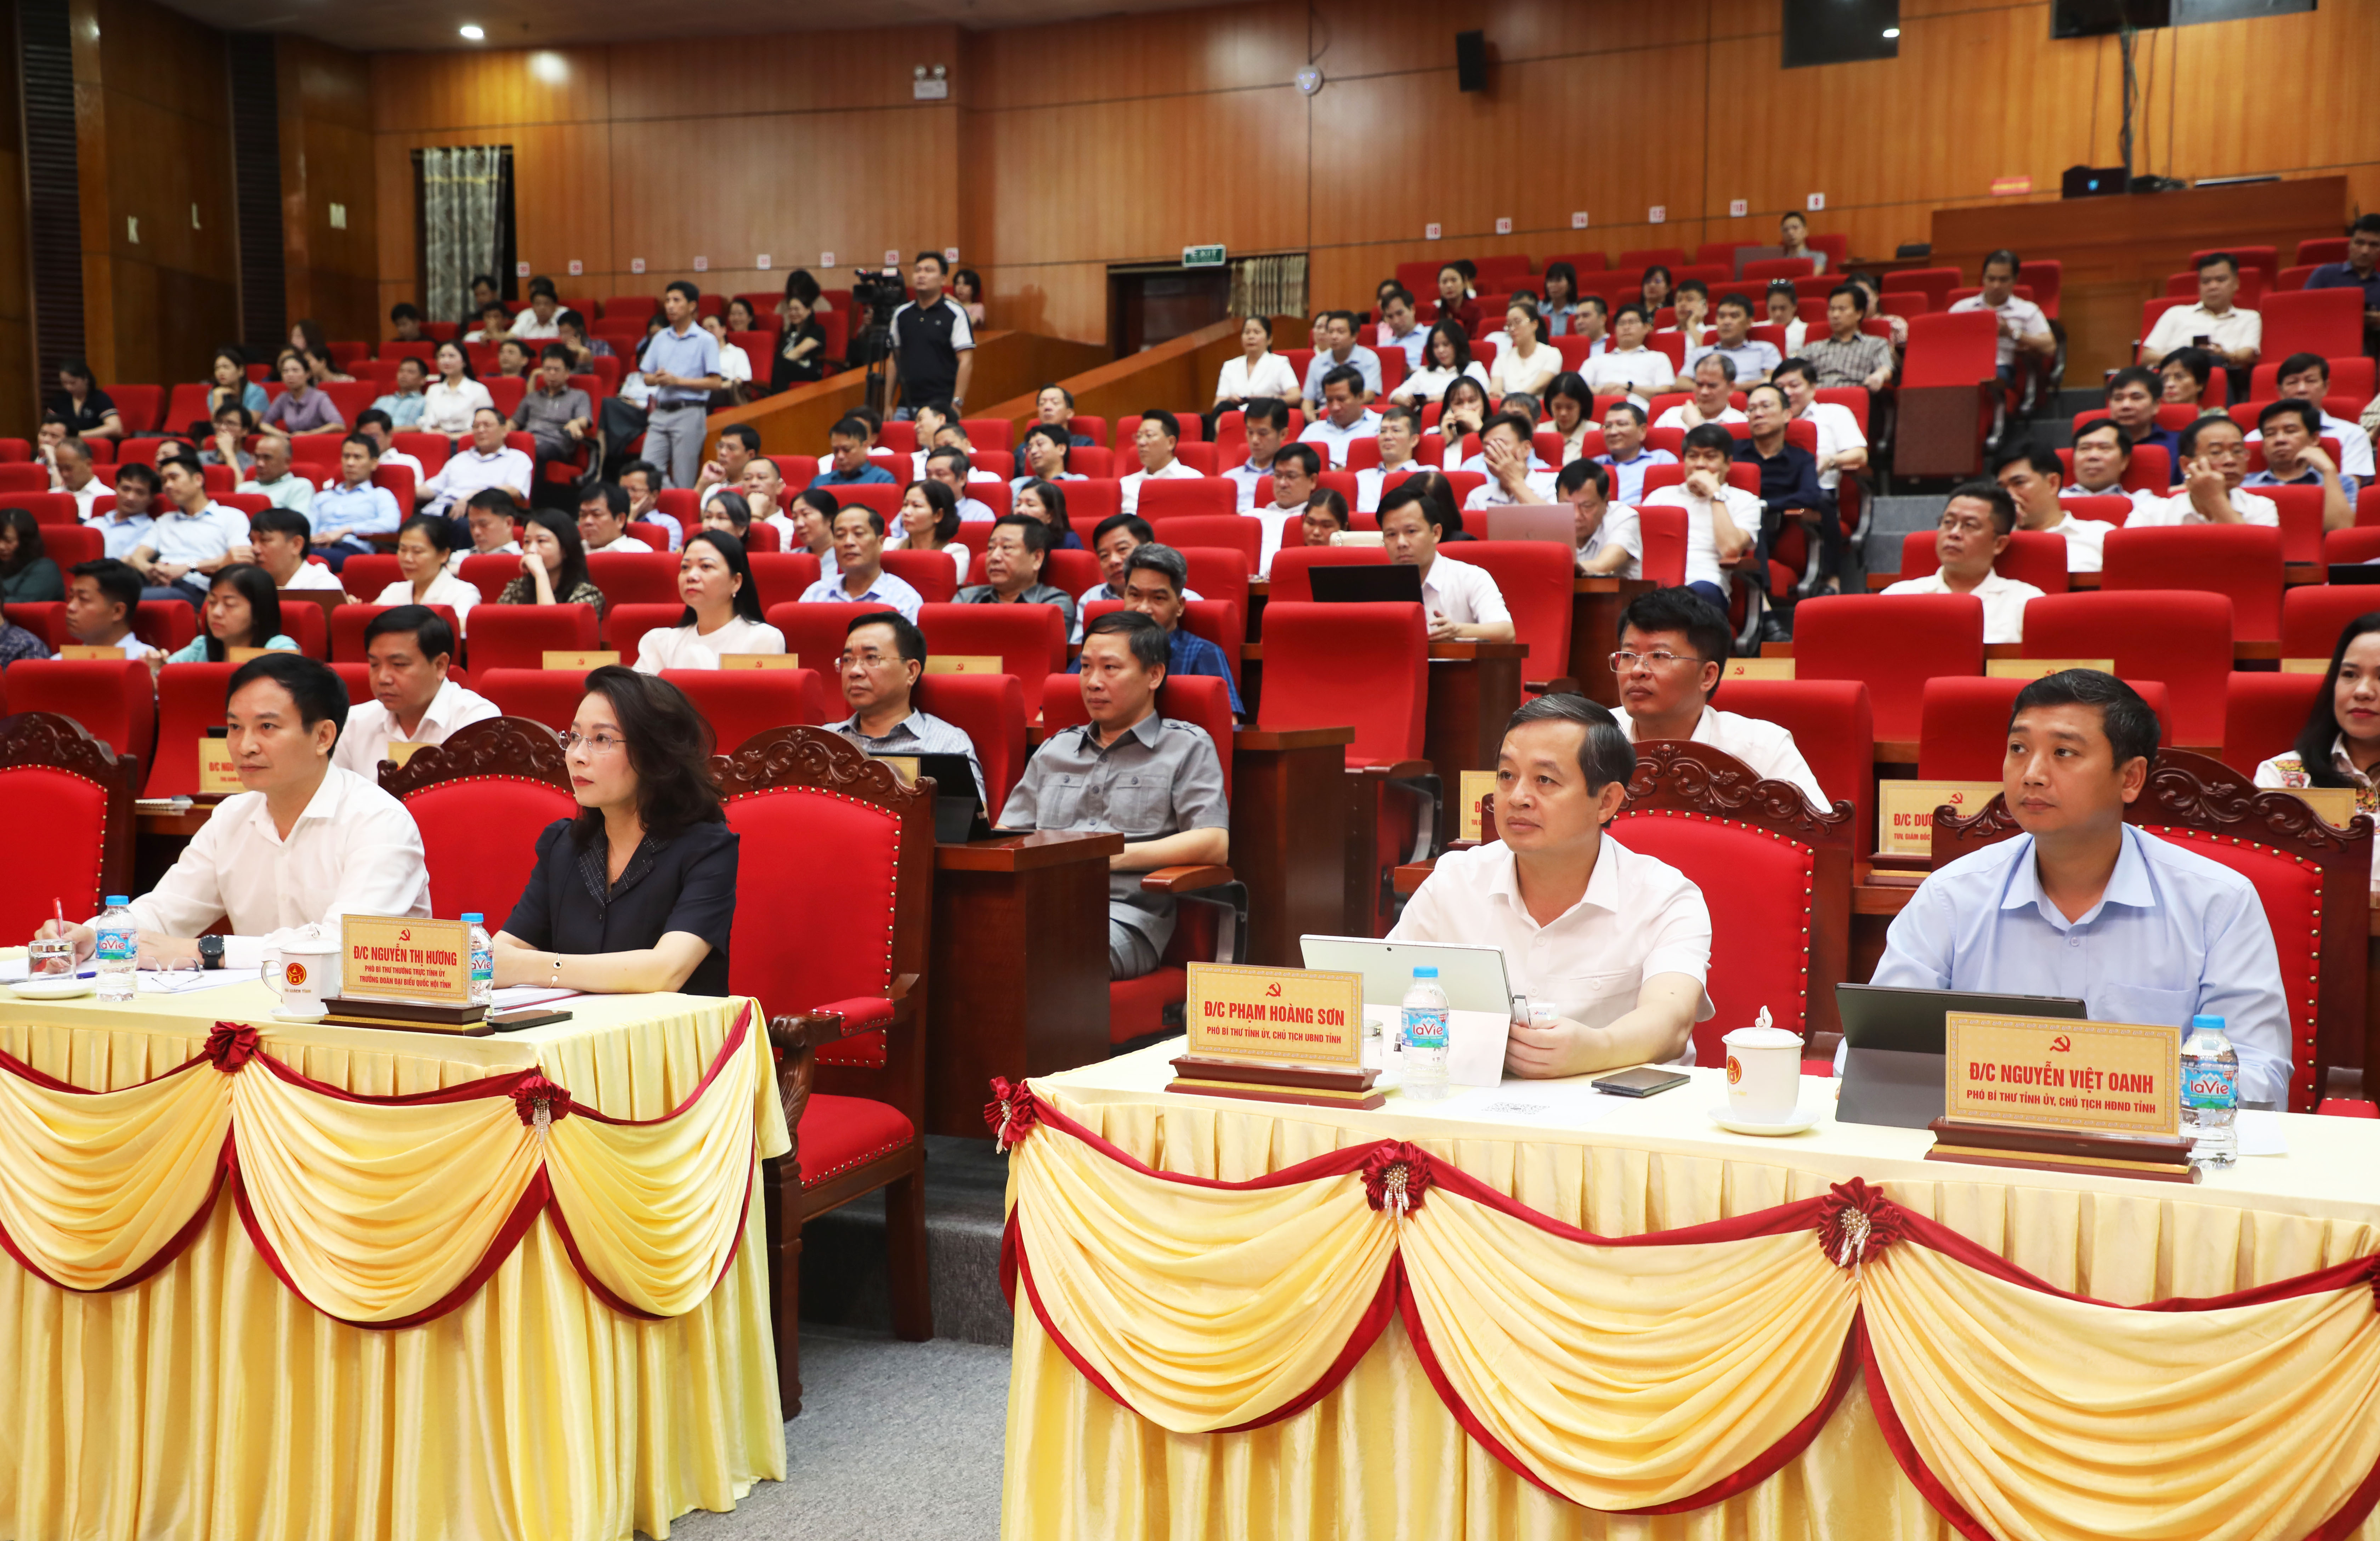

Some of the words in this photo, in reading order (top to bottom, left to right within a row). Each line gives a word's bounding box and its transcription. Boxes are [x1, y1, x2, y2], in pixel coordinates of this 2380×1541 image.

[1894, 813, 1911, 826] Đ/C
[99, 939, 125, 949] laVie
[353, 945, 369, 960] Đ/C
[371, 943, 407, 962] NGUYỄN
[409, 949, 423, 967] THỊ
[426, 950, 457, 966] HƯƠNG
[471, 959, 491, 969] aVie
[392, 967, 412, 975] THƯỜNG
[426, 968, 438, 977] TỈNH
[439, 968, 445, 977] ỦY
[403, 977, 415, 986] BIỂU
[416, 979, 429, 987] QUỐC
[430, 980, 439, 988] HỘI
[440, 980, 451, 989] TỈNH
[1204, 1001, 1225, 1018] Đ/C
[1229, 1002, 1266, 1023] PHẠM
[1270, 1003, 1313, 1024] HOÀNG
[1318, 1007, 1344, 1026] SƠN
[1207, 1025, 1220, 1035] PHÓ
[1222, 1027, 1229, 1035] BÍ
[1230, 1028, 1243, 1036] THƯ
[1245, 1028, 1259, 1038] TỈNH
[1261, 1028, 1271, 1039] ỦY,
[1273, 1029, 1286, 1040] CHỦ
[1288, 1031, 1303, 1042] TỊCH
[1305, 1034, 1324, 1042] UBND
[1326, 1033, 1341, 1044] TỈNH
[1413, 1023, 1443, 1035] laVie
[1970, 1062, 1996, 1082] Đ/C
[2001, 1061, 2064, 1087] NGUYỄN
[2069, 1067, 2104, 1093] VIỆT
[2108, 1072, 2153, 1094] OANH
[2191, 1080, 2229, 1094] laVie
[1967, 1089, 1985, 1100] PHÓ
[1988, 1090, 1997, 1101] BÍ
[1999, 1092, 2018, 1102] THƯ
[2020, 1091, 2040, 1104] TỈNH
[2043, 1093, 2056, 1107] ỦY,
[2059, 1095, 2078, 1108] CHỦ
[2081, 1098, 2102, 1110] TỊCH
[2104, 1101, 2131, 1111] HĐND
[2134, 1101, 2156, 1114] TỈNH
